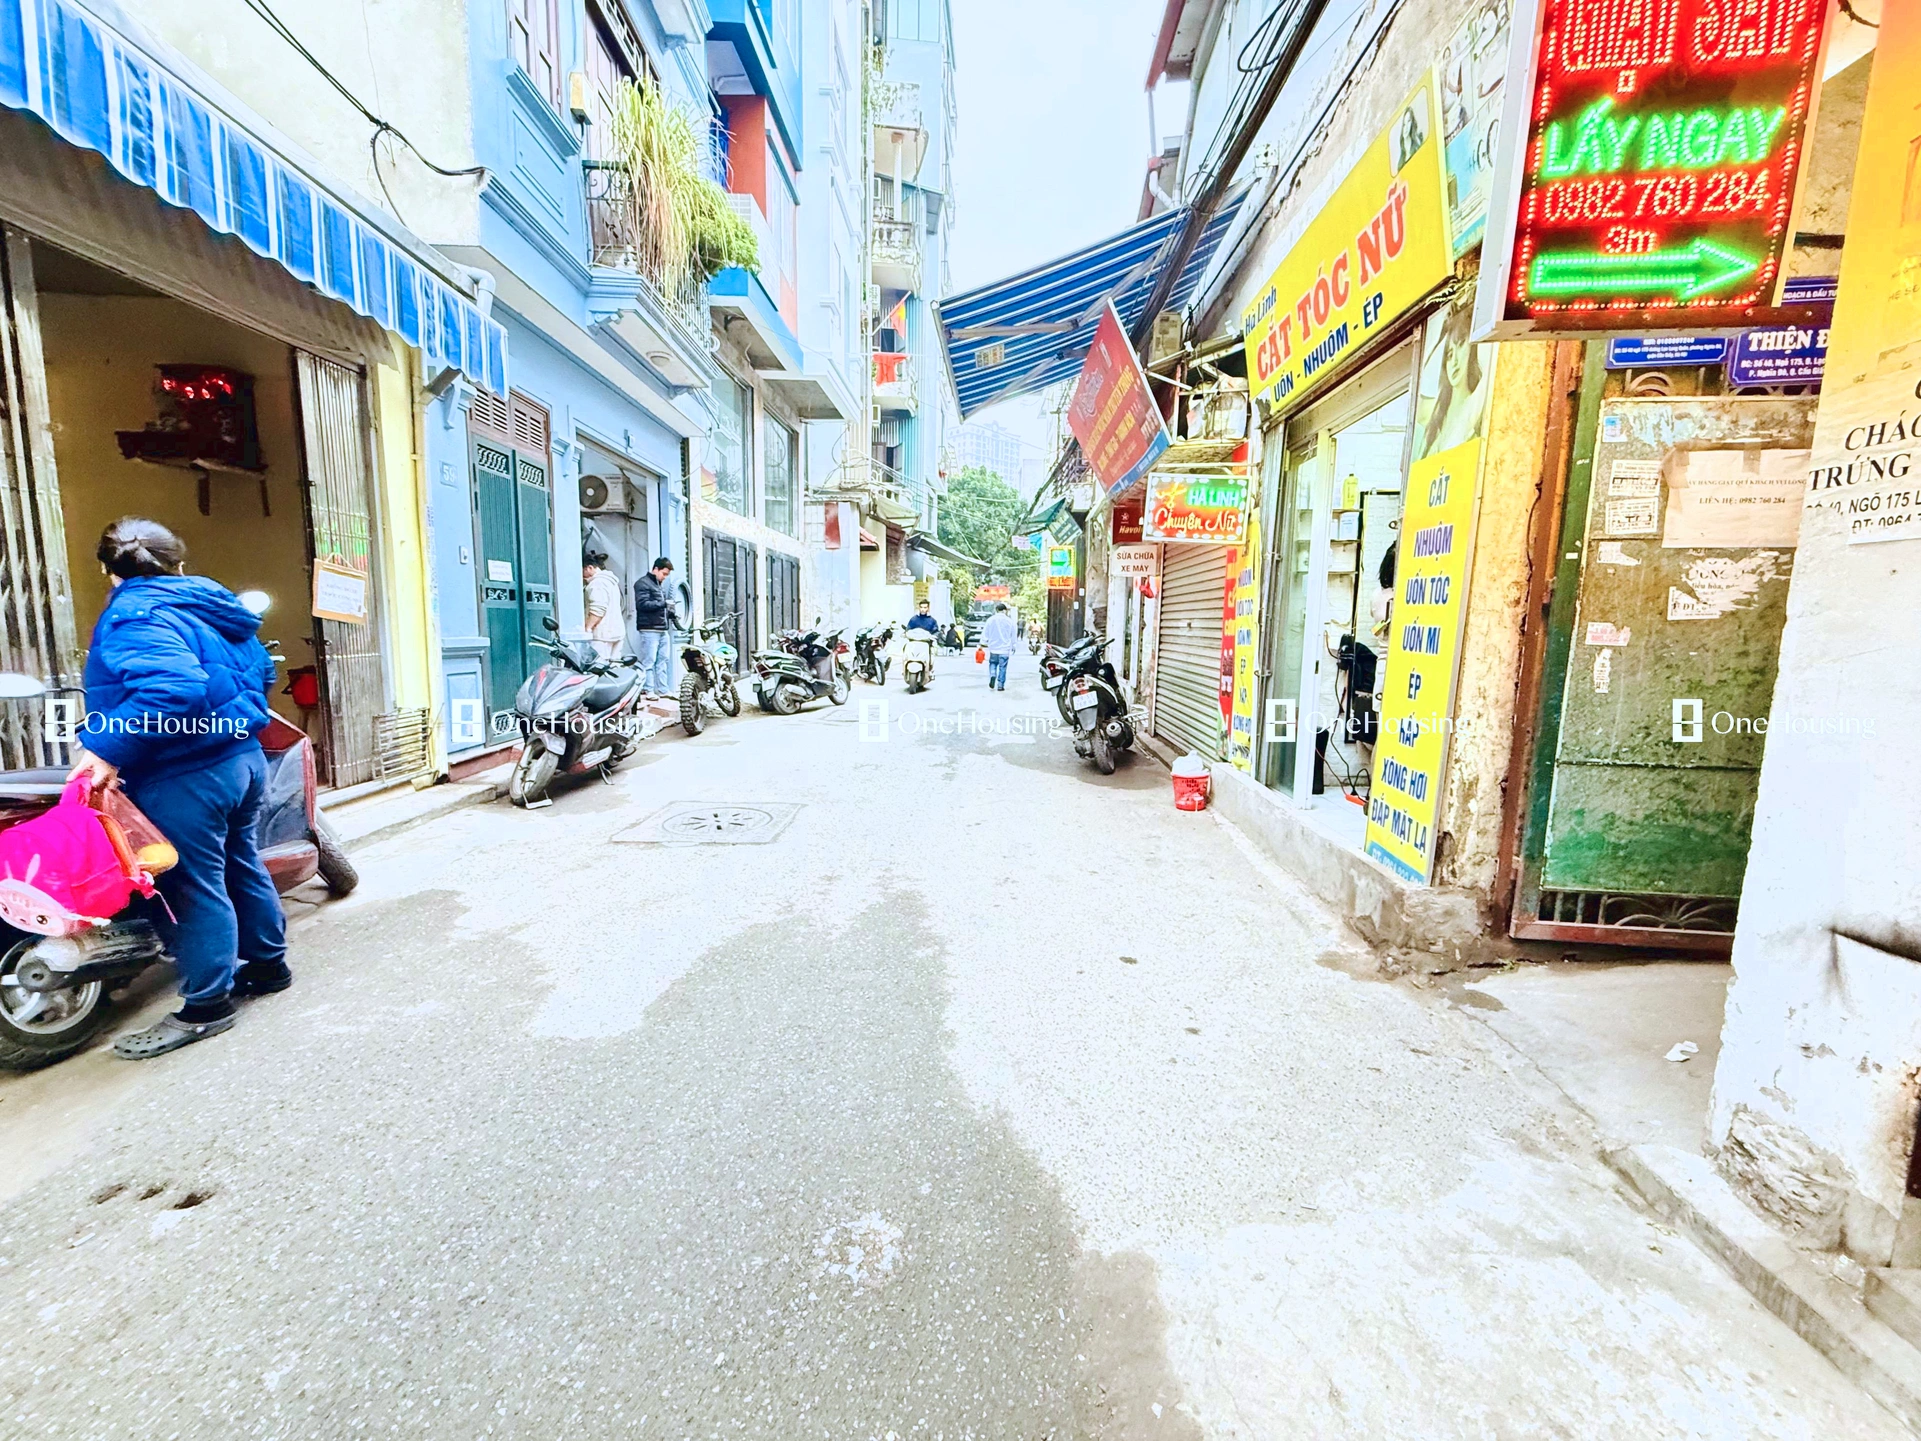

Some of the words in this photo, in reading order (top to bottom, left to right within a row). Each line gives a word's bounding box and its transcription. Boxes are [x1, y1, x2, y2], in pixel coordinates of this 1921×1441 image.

[1545, 97, 1642, 173] LẤY
[1641, 107, 1786, 169] NGAY
[1544, 179, 1626, 221] 0982
[1633, 174, 1698, 216] 760
[1701, 168, 1772, 212] 284
[1605, 225, 1658, 254] 3m
[1257, 309, 1293, 381] CẮT
[1296, 253, 1350, 341] TÓC
[1356, 181, 1410, 288] NỮ
[1244, 313, 1258, 338] Hà
[1256, 285, 1277, 324] Linh
[1273, 371, 1295, 403] UỐN
[1303, 320, 1349, 377] NHUỘM
[1363, 290, 1385, 330] ÉP
[1748, 325, 1813, 354] THIỆN
[1429, 466, 1451, 508] CẮT
[1809, 452, 1912, 492] TRỨNG
[1187, 486, 1208, 507] HÀ
[1209, 488, 1240, 508] LINH
[1848, 492, 1881, 514] NGÕ
[1886, 491, 1911, 509] 175
[1154, 507, 1204, 535] Chuyên
[1205, 509, 1237, 532] Nữ
[1413, 520, 1454, 562] NHUỘM
[1121, 564, 1131, 572] XE
[1132, 564, 1149, 572] MÁY
[1405, 568, 1426, 605] UỐN
[1429, 570, 1451, 605] TÓC
[1402, 616, 1425, 652] UỐN
[1425, 626, 1441, 655] MI
[1407, 667, 1422, 701] ÉP
[1380, 755, 1407, 794] XÔNG
[1408, 769, 1428, 802] HƠI
[1371, 793, 1390, 828] ĐẮP
[1390, 809, 1413, 845] MẶT
[1413, 823, 1428, 858] LẠ
